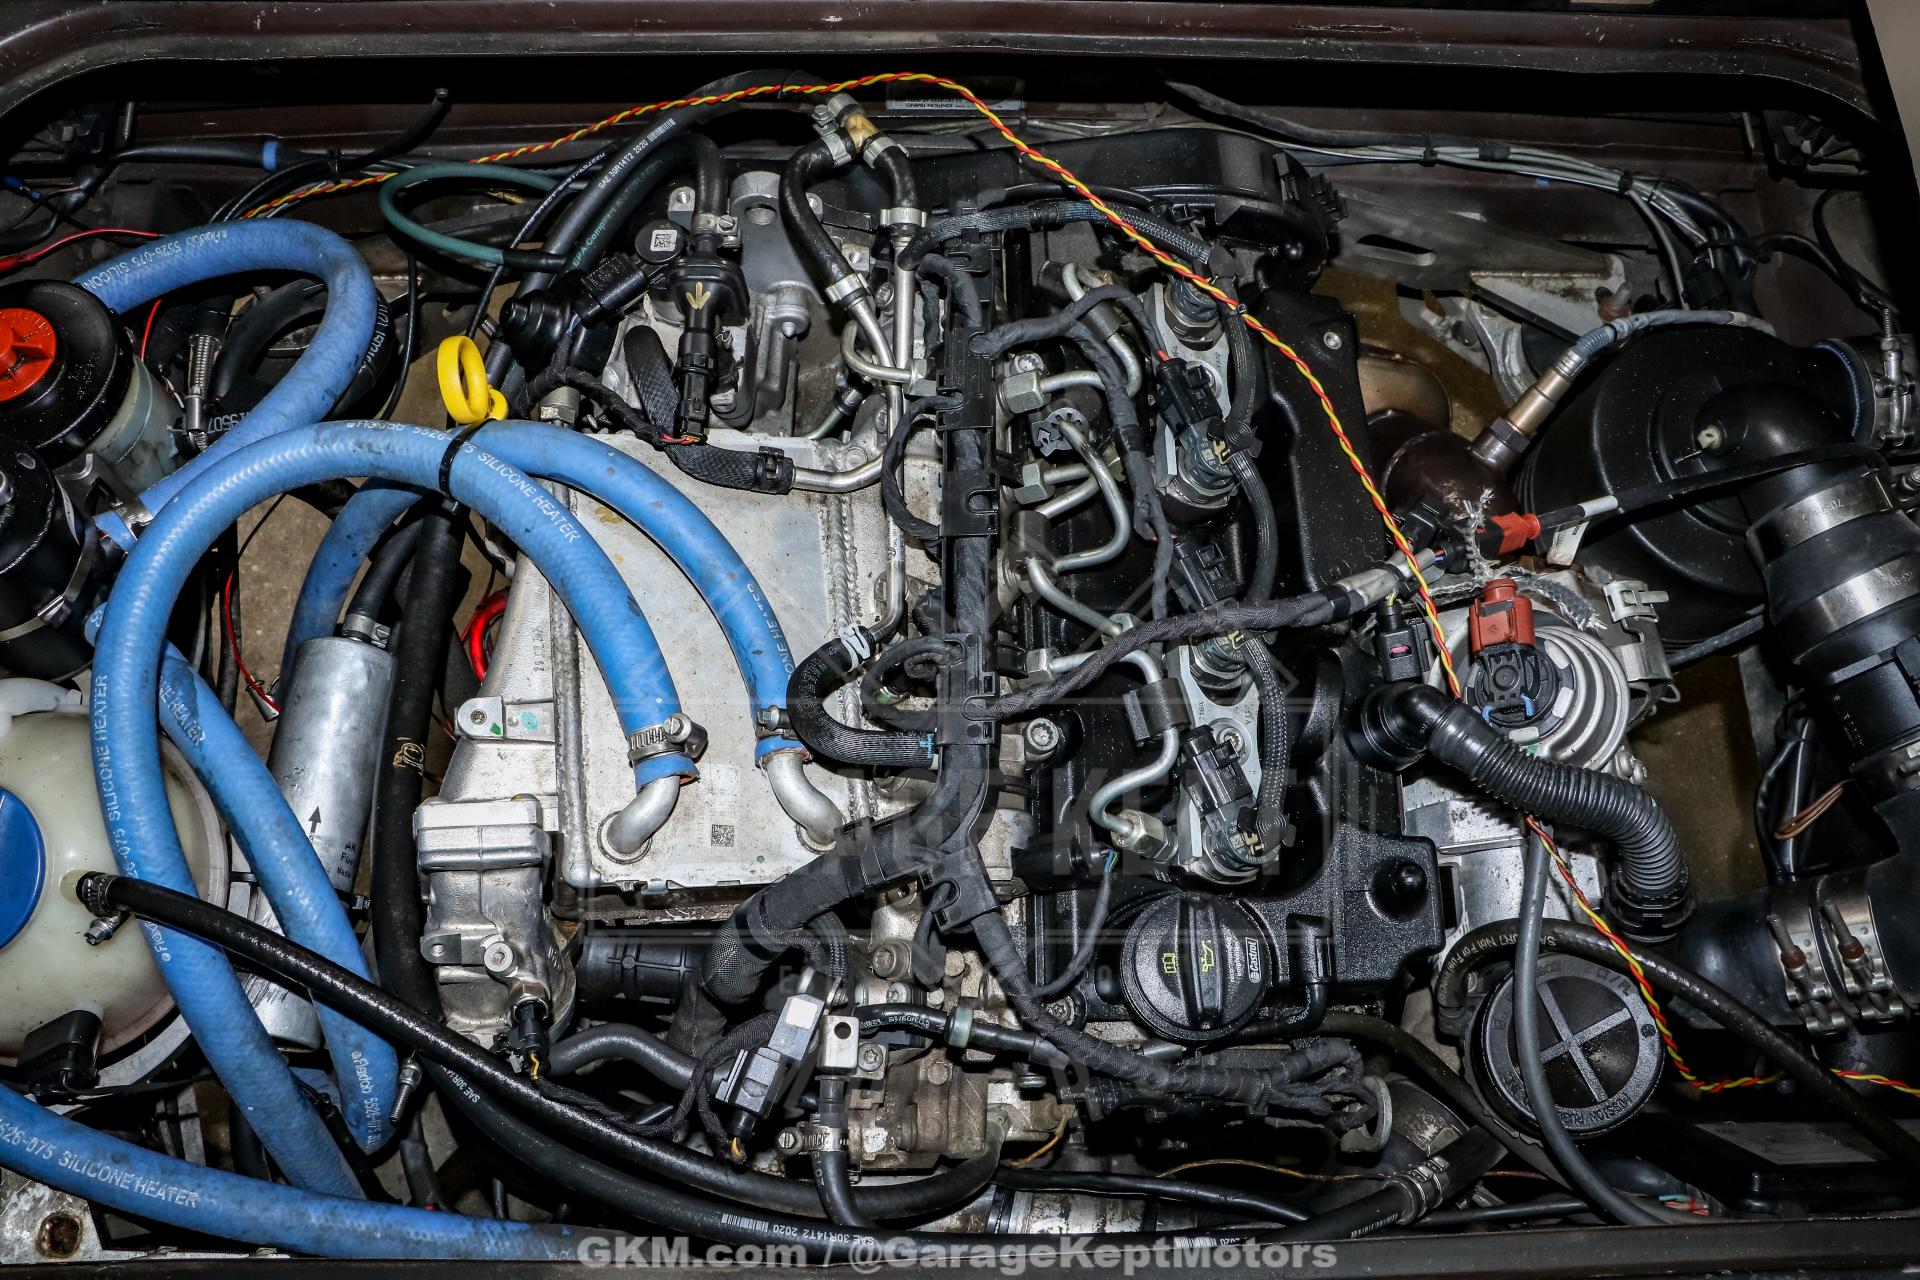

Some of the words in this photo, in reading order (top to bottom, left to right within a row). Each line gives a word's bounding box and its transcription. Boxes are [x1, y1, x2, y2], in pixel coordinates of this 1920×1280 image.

[598, 174, 611, 190] SAE
[632, 139, 649, 155] 2020
[572, 246, 588, 268] EPA
[81, 261, 130, 290] SILICON
[477, 451, 538, 498] SILICONE
[531, 494, 583, 544] HEATER
[93, 674, 108, 742] HEATER
[95, 746, 121, 822] SILICONE
[1247, 940, 1259, 973] Castrol
[464, 1086, 481, 1103] SAE
[58, 1150, 135, 1191] SILICONE
[133, 1174, 200, 1209] HEATER
[772, 1223, 798, 1237] 2020
[802, 1228, 851, 1243] 30R14T2
[852, 1233, 875, 1245] SAE
